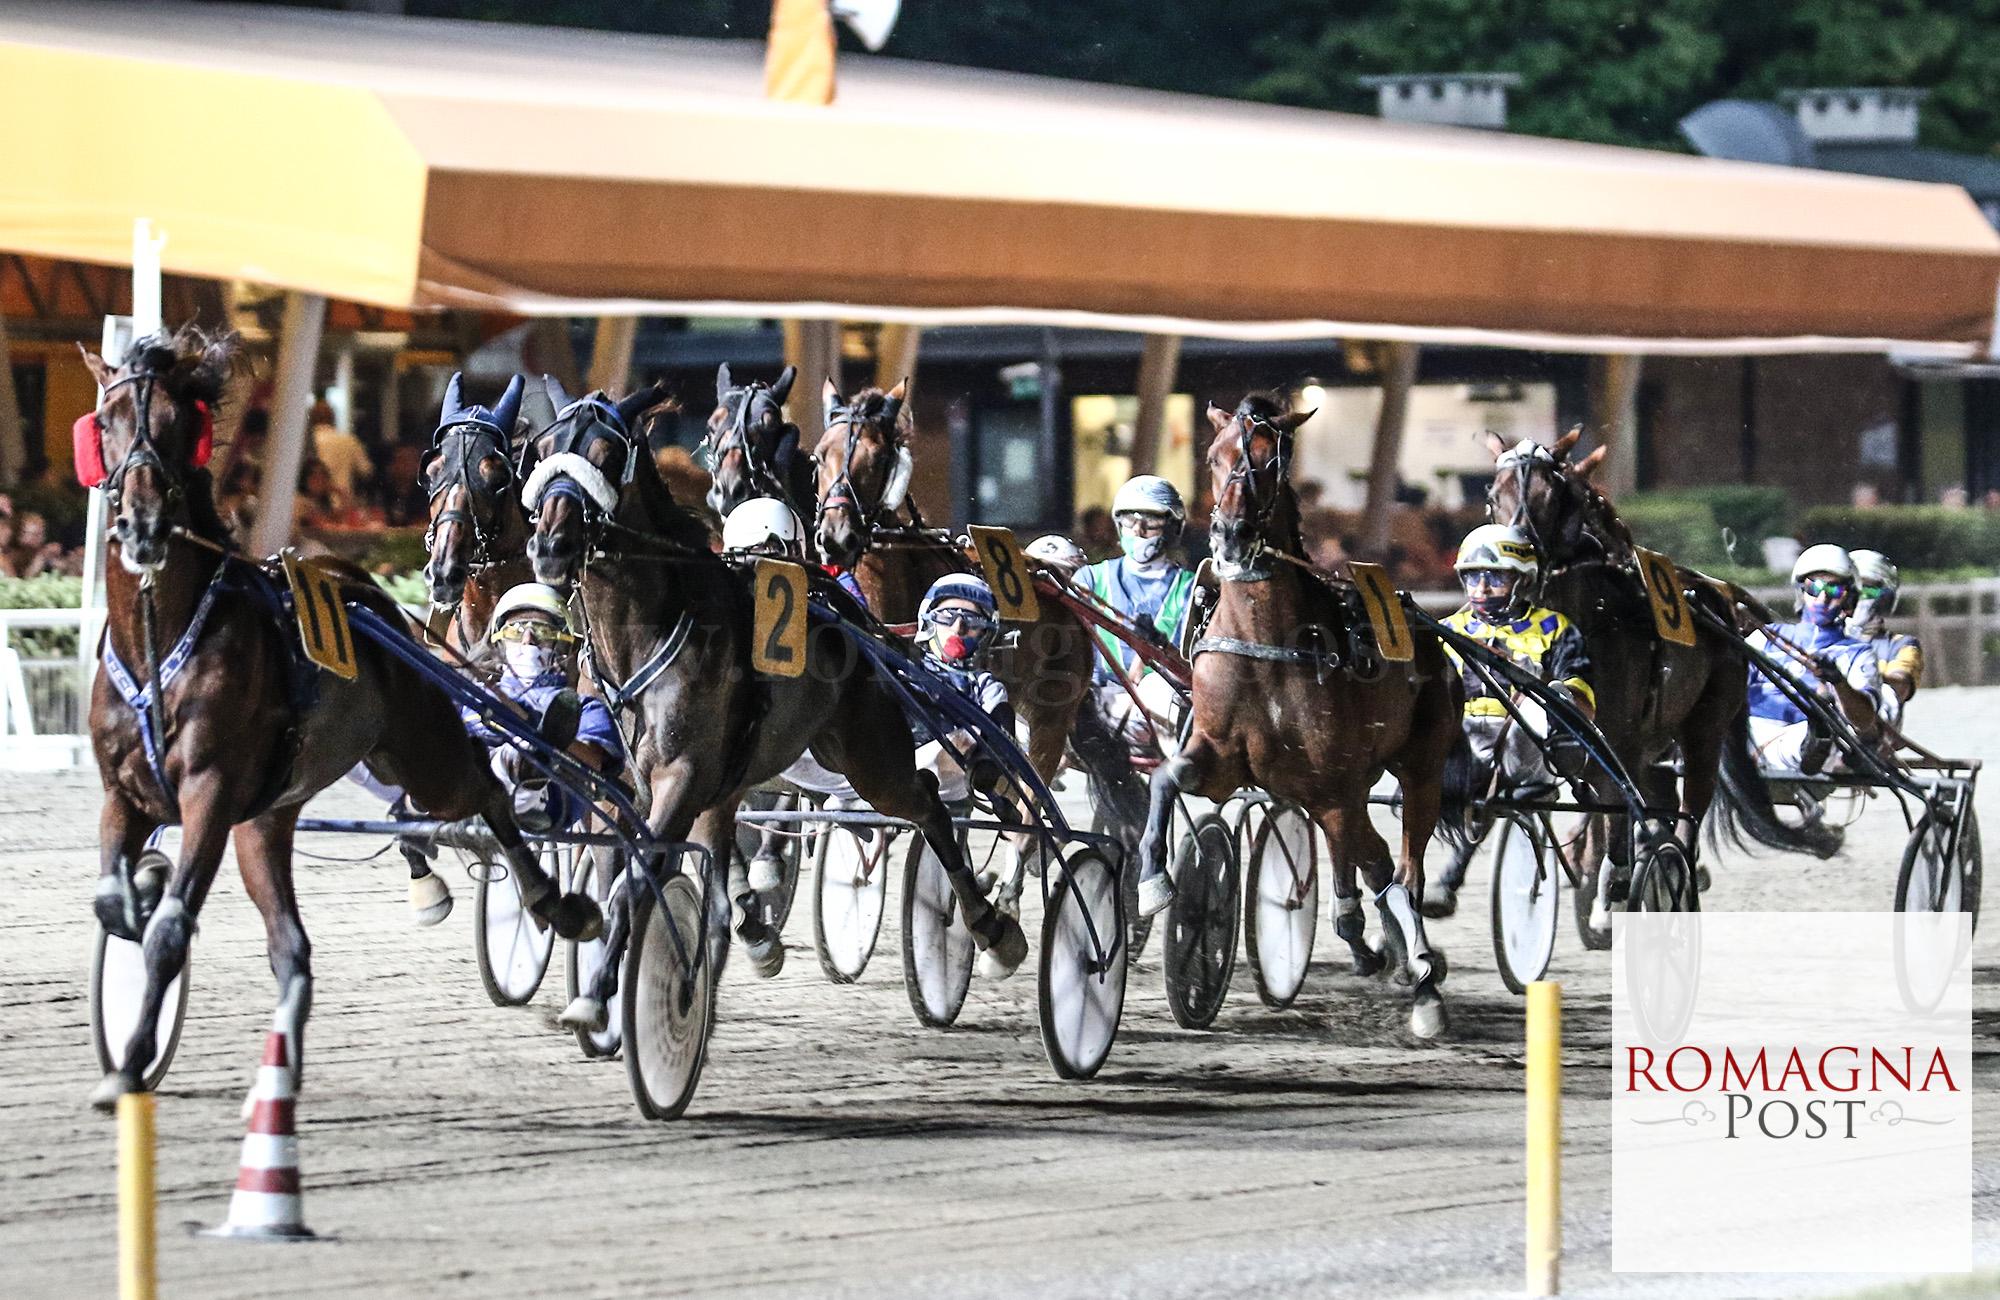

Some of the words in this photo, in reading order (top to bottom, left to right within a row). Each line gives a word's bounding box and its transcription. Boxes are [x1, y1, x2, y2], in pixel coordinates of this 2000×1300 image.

[985, 536, 1024, 607] 8
[1649, 560, 1681, 630] 9
[295, 566, 349, 664] 11
[765, 574, 794, 662] 2
[1366, 573, 1398, 647] 1
